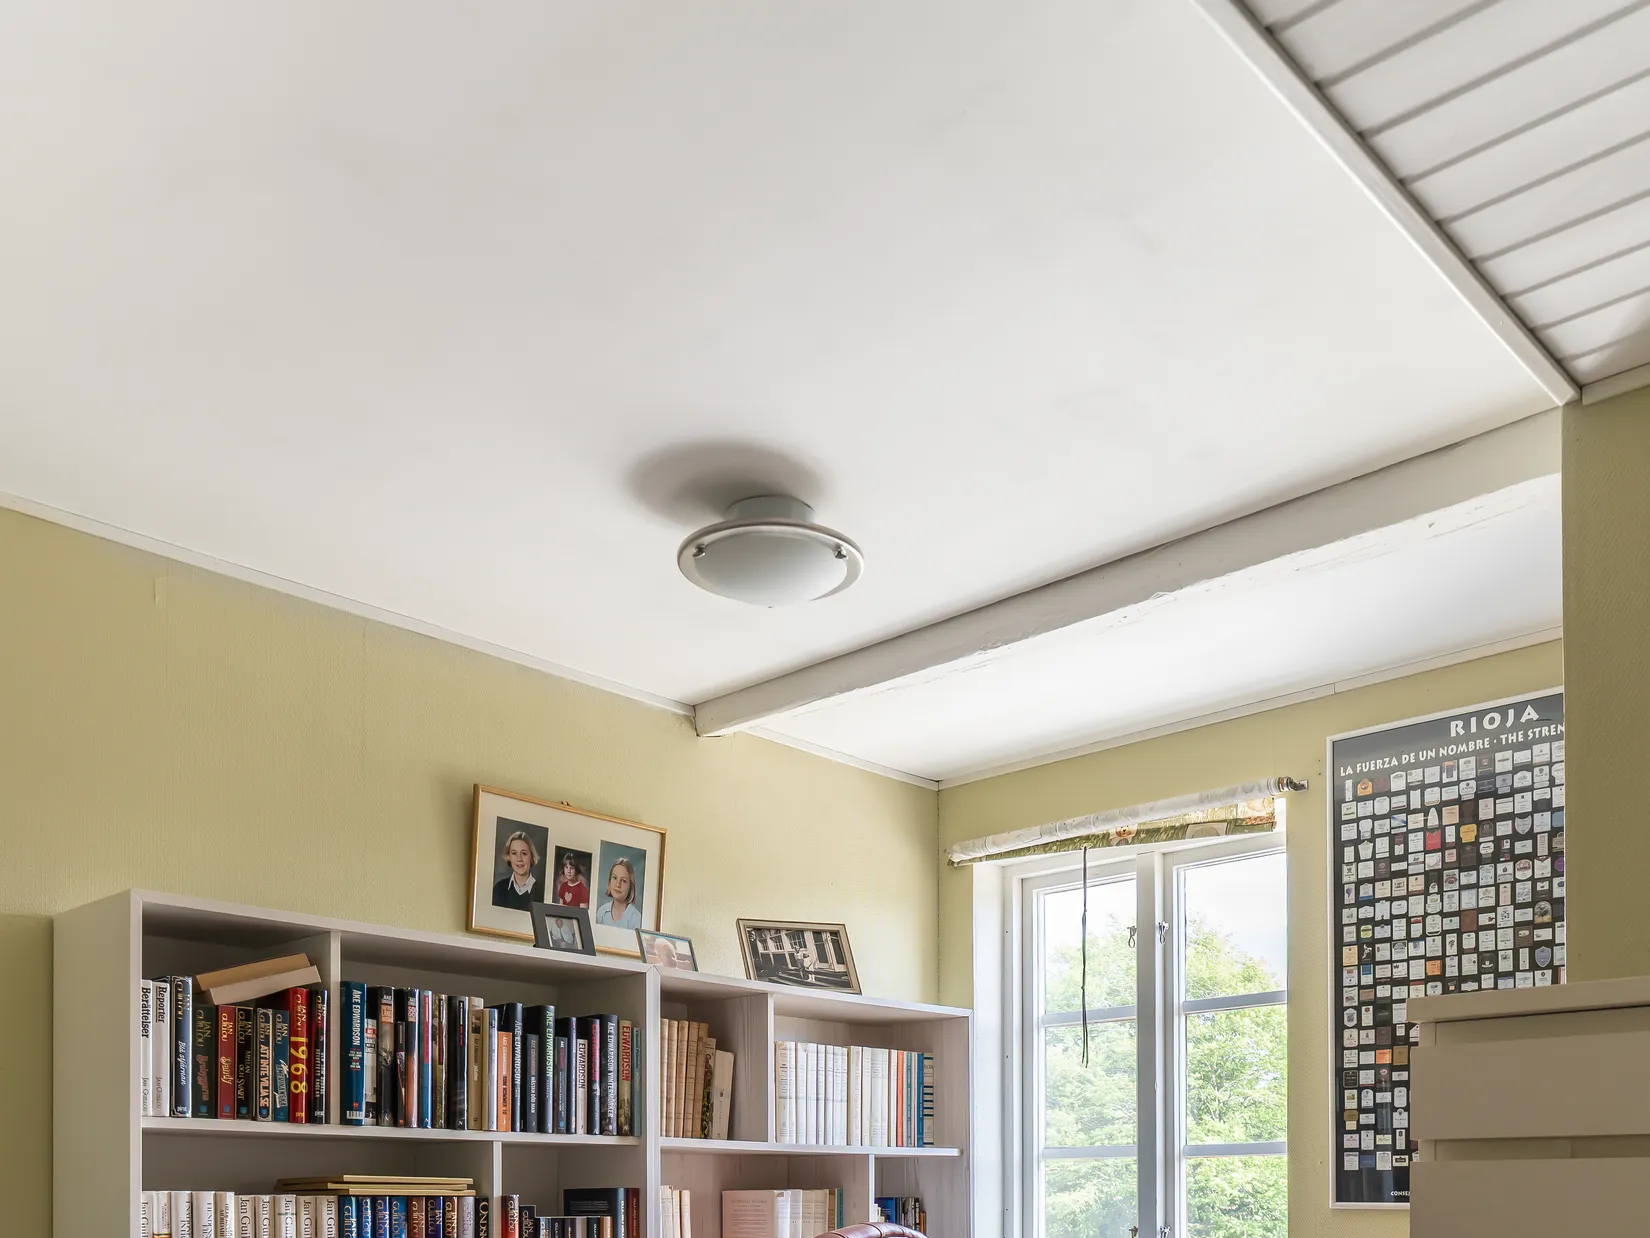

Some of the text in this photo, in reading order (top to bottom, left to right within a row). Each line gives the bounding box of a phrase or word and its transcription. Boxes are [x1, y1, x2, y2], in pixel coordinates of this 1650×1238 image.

[1450, 704, 1539, 738] RIOJA
[1340, 766, 1353, 776] LA
[1356, 758, 1398, 773] FUERZA
[1401, 753, 1416, 764] DE
[1419, 749, 1435, 761] UN
[1439, 738, 1490, 758] NOMBRE
[1500, 731, 1524, 746] THE
[141, 987, 151, 1039] Berättelser
[158, 986, 167, 1023] Reporter
[352, 989, 362, 1003] ÅKE
[195, 1009, 205, 1047] GUILLOU
[238, 1011, 246, 1043] GUILLOU
[352, 1004, 361, 1046] EDWARDSON
[514, 1021, 522, 1035] ÅKE
[607, 1021, 615, 1034] ÅKE
[290, 1036, 308, 1094] 1968
[622, 1025, 630, 1082] EDWARDSON
[260, 1044, 269, 1107] ATT INTE VILJA SE
[607, 1072, 615, 1118] VINTERMÖRKER
[240, 1197, 250, 1214] Jan
[261, 1199, 270, 1215] Jan
[284, 1198, 292, 1215] Jan
[303, 1199, 312, 1216] Jan
[326, 1198, 335, 1215] Jan
[376, 1200, 385, 1238] GUILLOU
[391, 1200, 400, 1238] GUILLOU
